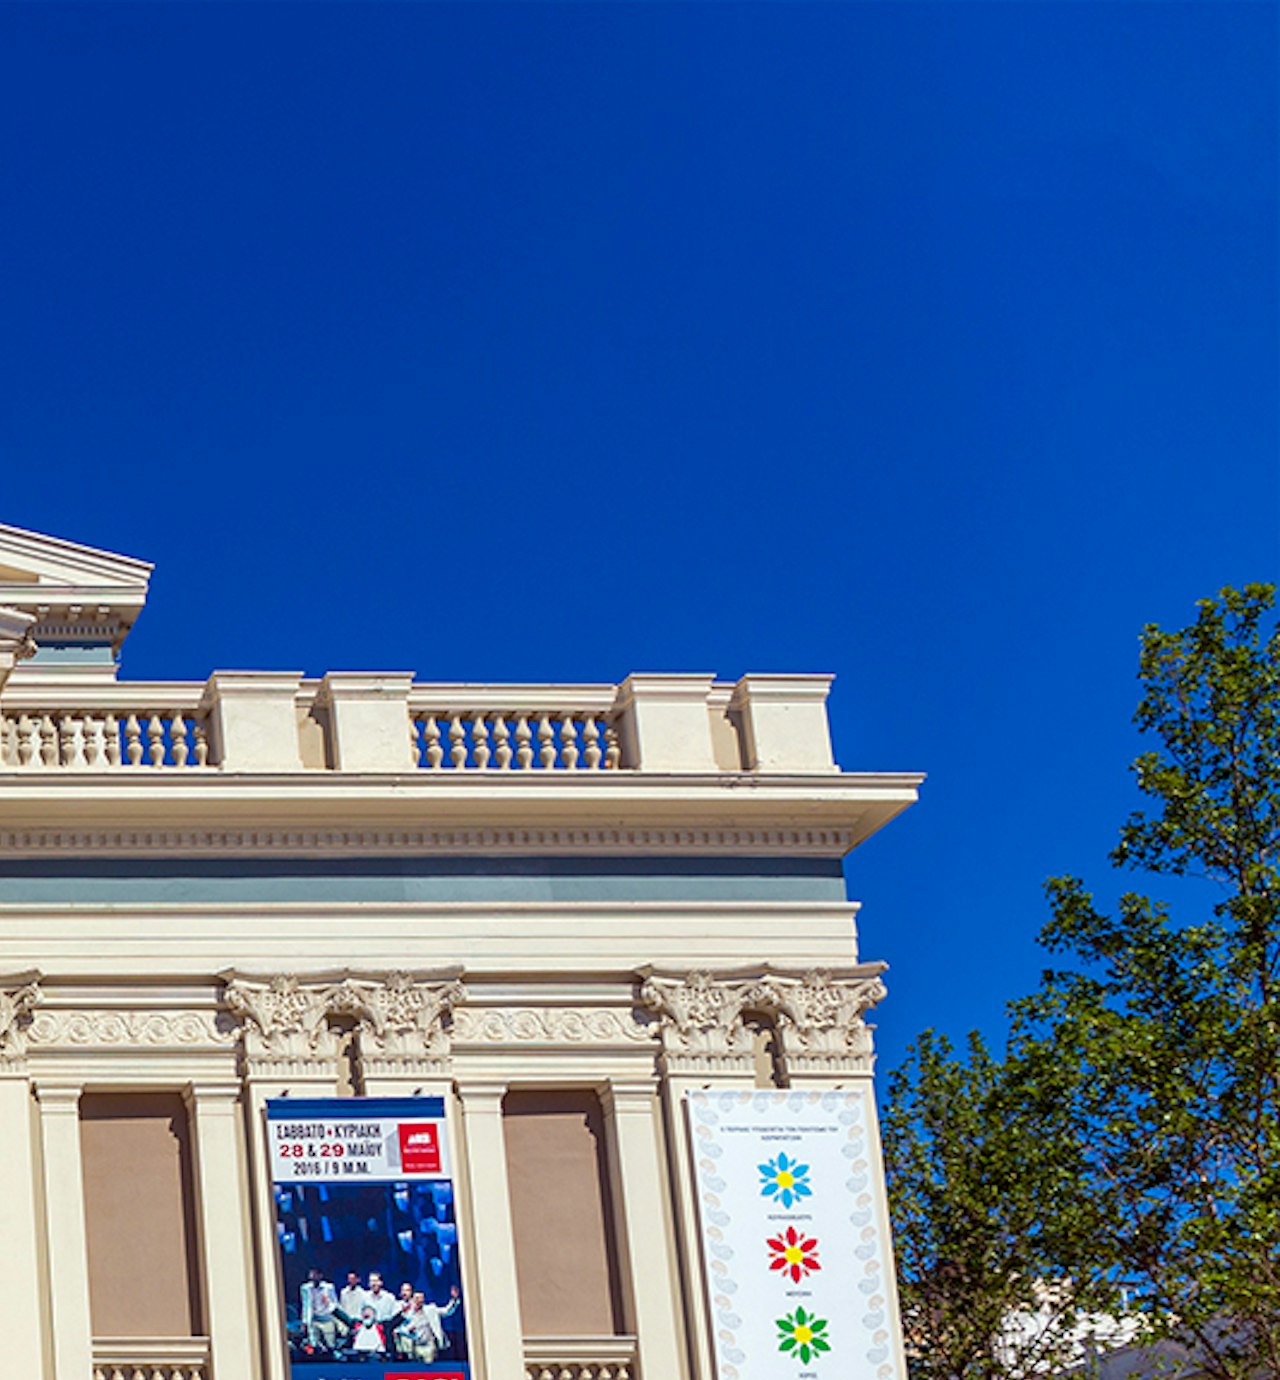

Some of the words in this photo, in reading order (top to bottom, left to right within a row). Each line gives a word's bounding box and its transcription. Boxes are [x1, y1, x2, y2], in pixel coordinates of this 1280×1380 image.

[277, 1123, 325, 1139] ΣΑΒΒΑΤΟ
[334, 1123, 381, 1138] ΚΥΡΙΑΚΗ
[279, 1144, 304, 1158] 28
[308, 1144, 317, 1157] &
[320, 1143, 345, 1157] 29
[293, 1162, 321, 1175] 2016
